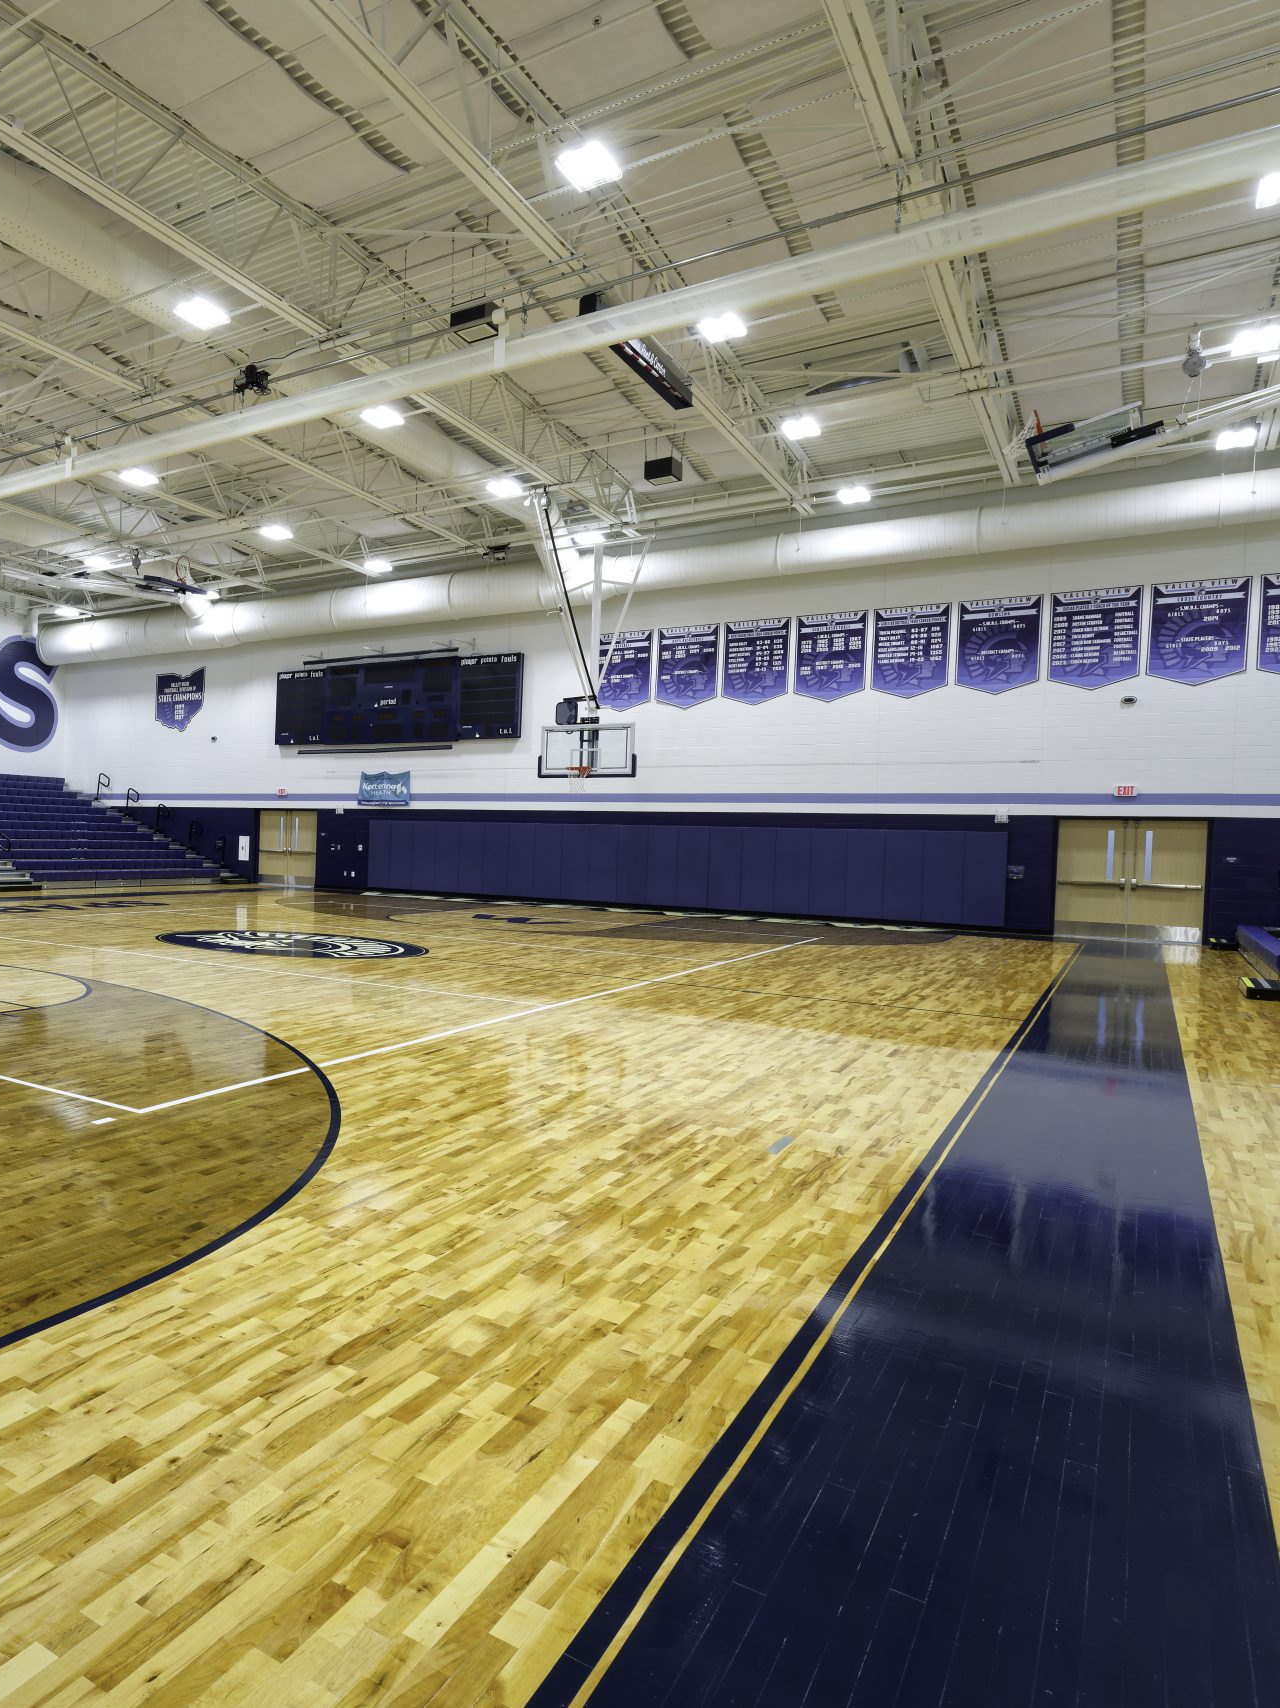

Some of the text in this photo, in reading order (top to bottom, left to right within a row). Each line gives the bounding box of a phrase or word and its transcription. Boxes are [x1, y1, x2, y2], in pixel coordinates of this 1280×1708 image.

[173, 692, 201, 701] CHAMPIONS
[380, 698, 396, 706] period
[363, 782, 396, 791] Kettering
[1117, 786, 1134, 796] EXIT
